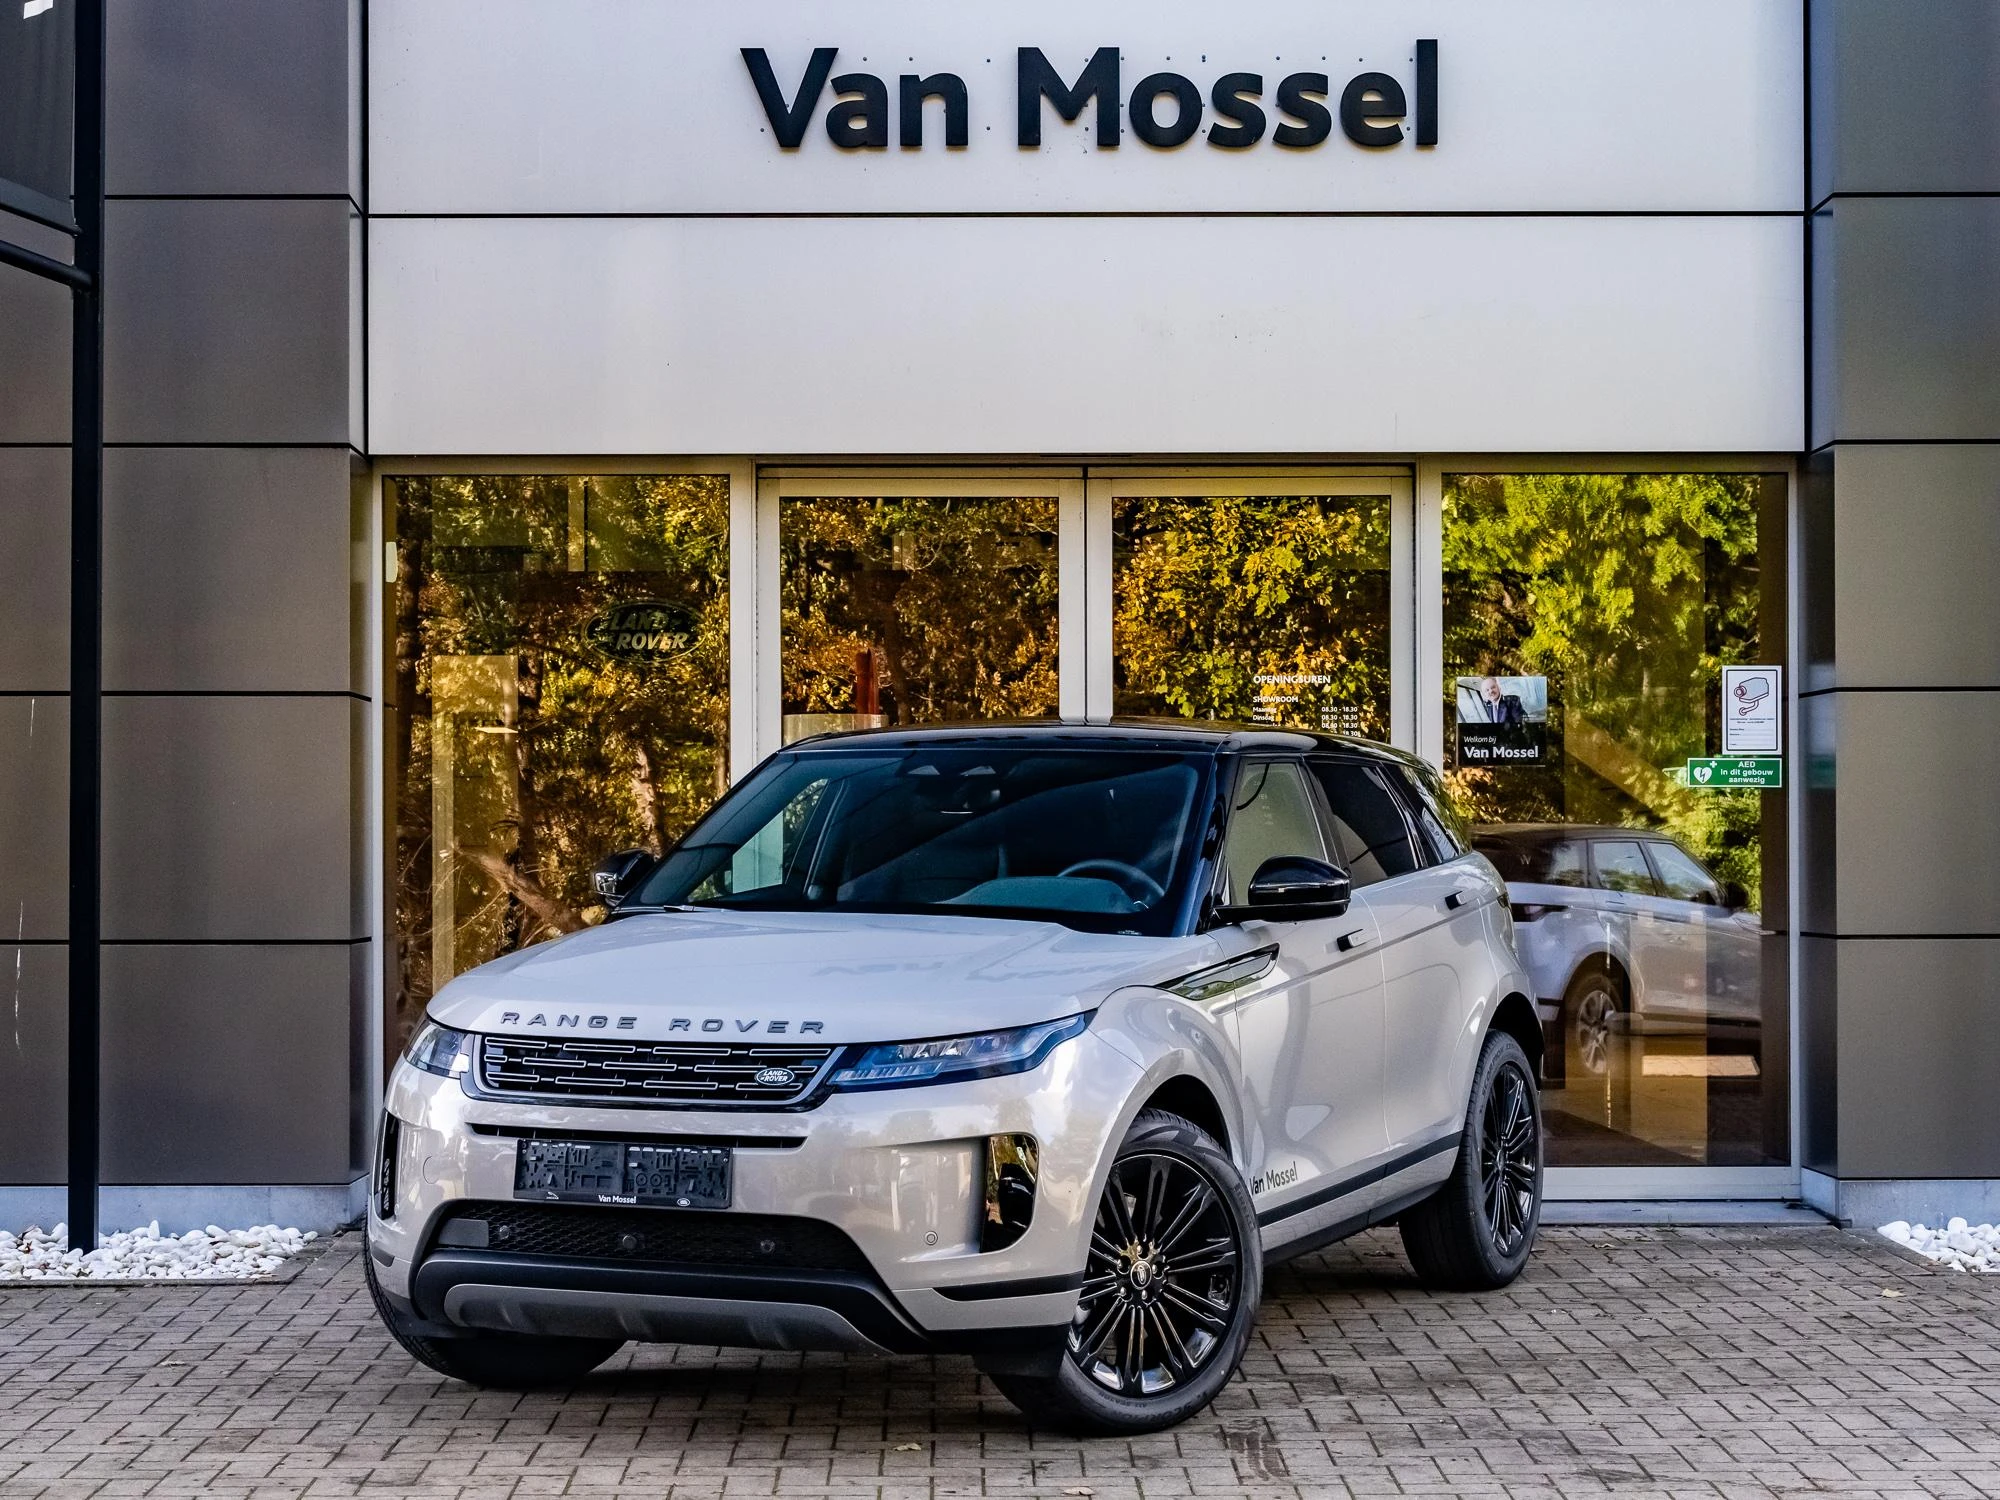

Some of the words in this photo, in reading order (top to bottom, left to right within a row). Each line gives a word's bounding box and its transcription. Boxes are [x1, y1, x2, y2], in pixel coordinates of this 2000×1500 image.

[740, 46, 968, 148] Van
[1017, 39, 1438, 148] Mossel
[610, 611, 669, 630] LAND
[616, 632, 689, 650] ROVER
[1252, 674, 1331, 684] OPENINGSUREN
[1252, 695, 1299, 703] SHOWROOM
[1488, 736, 1497, 744] bij
[1463, 746, 1489, 758] Van
[1492, 745, 1539, 758] Mossel
[1737, 760, 1756, 768] AED
[1742, 768, 1774, 777] gebouw
[1728, 777, 1766, 785] aanwezig
[500, 1011, 638, 1030] RANGE
[668, 1017, 825, 1035] ROVER
[1249, 1175, 1265, 1196] Van
[1265, 1160, 1298, 1190] Mossel
[598, 1194, 611, 1203] Van
[612, 1195, 637, 1204] Mossel
